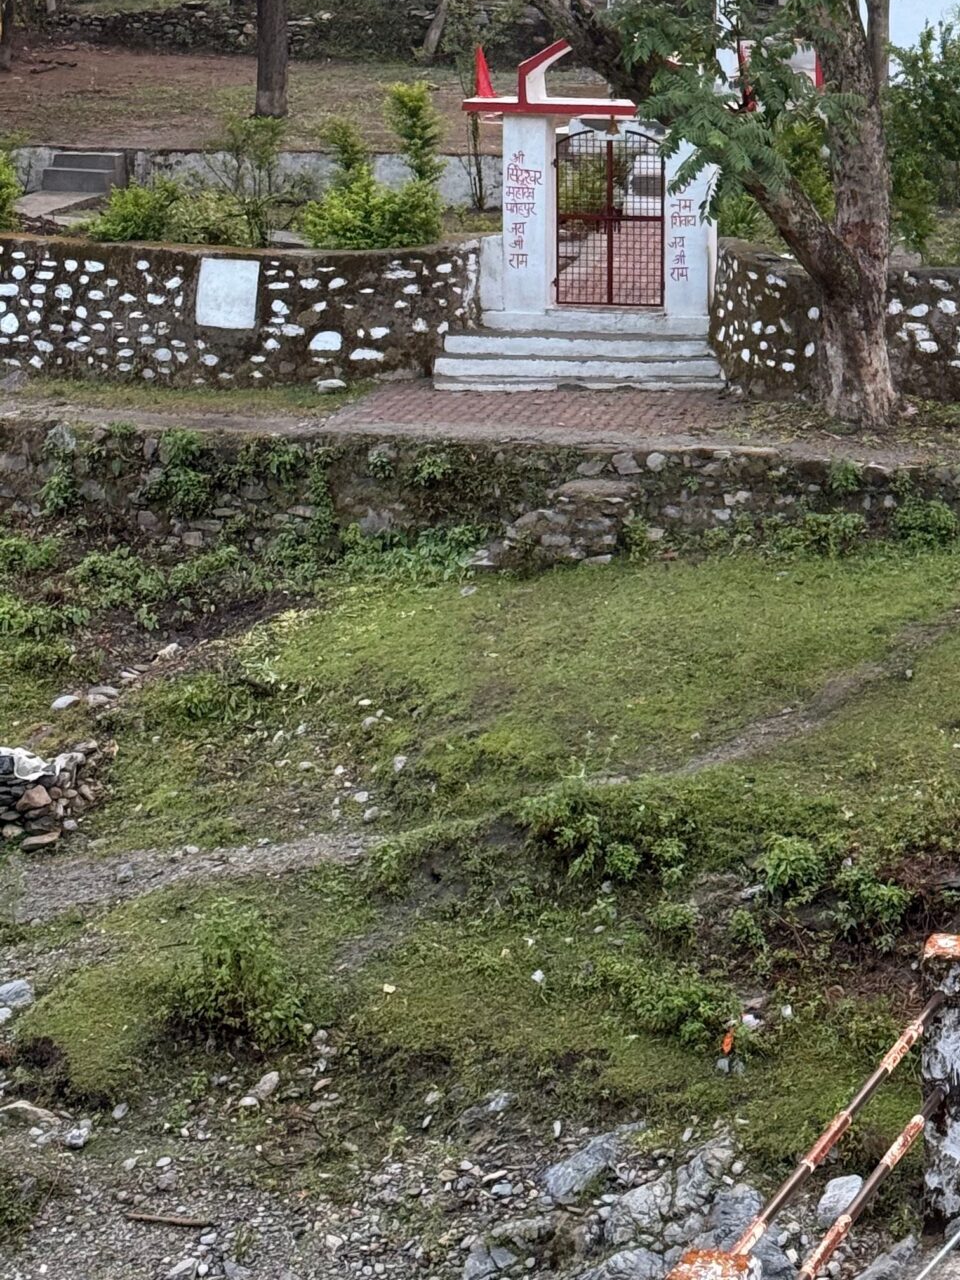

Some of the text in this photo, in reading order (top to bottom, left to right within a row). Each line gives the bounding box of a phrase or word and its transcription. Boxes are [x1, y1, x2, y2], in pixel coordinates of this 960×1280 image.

[671, 212, 696, 228] शिवाय
[506, 222, 527, 235] जय
[668, 237, 686, 249] जय
[509, 253, 529, 269] राम
[672, 249, 686, 265] श्री
[670, 267, 689, 282] राम
